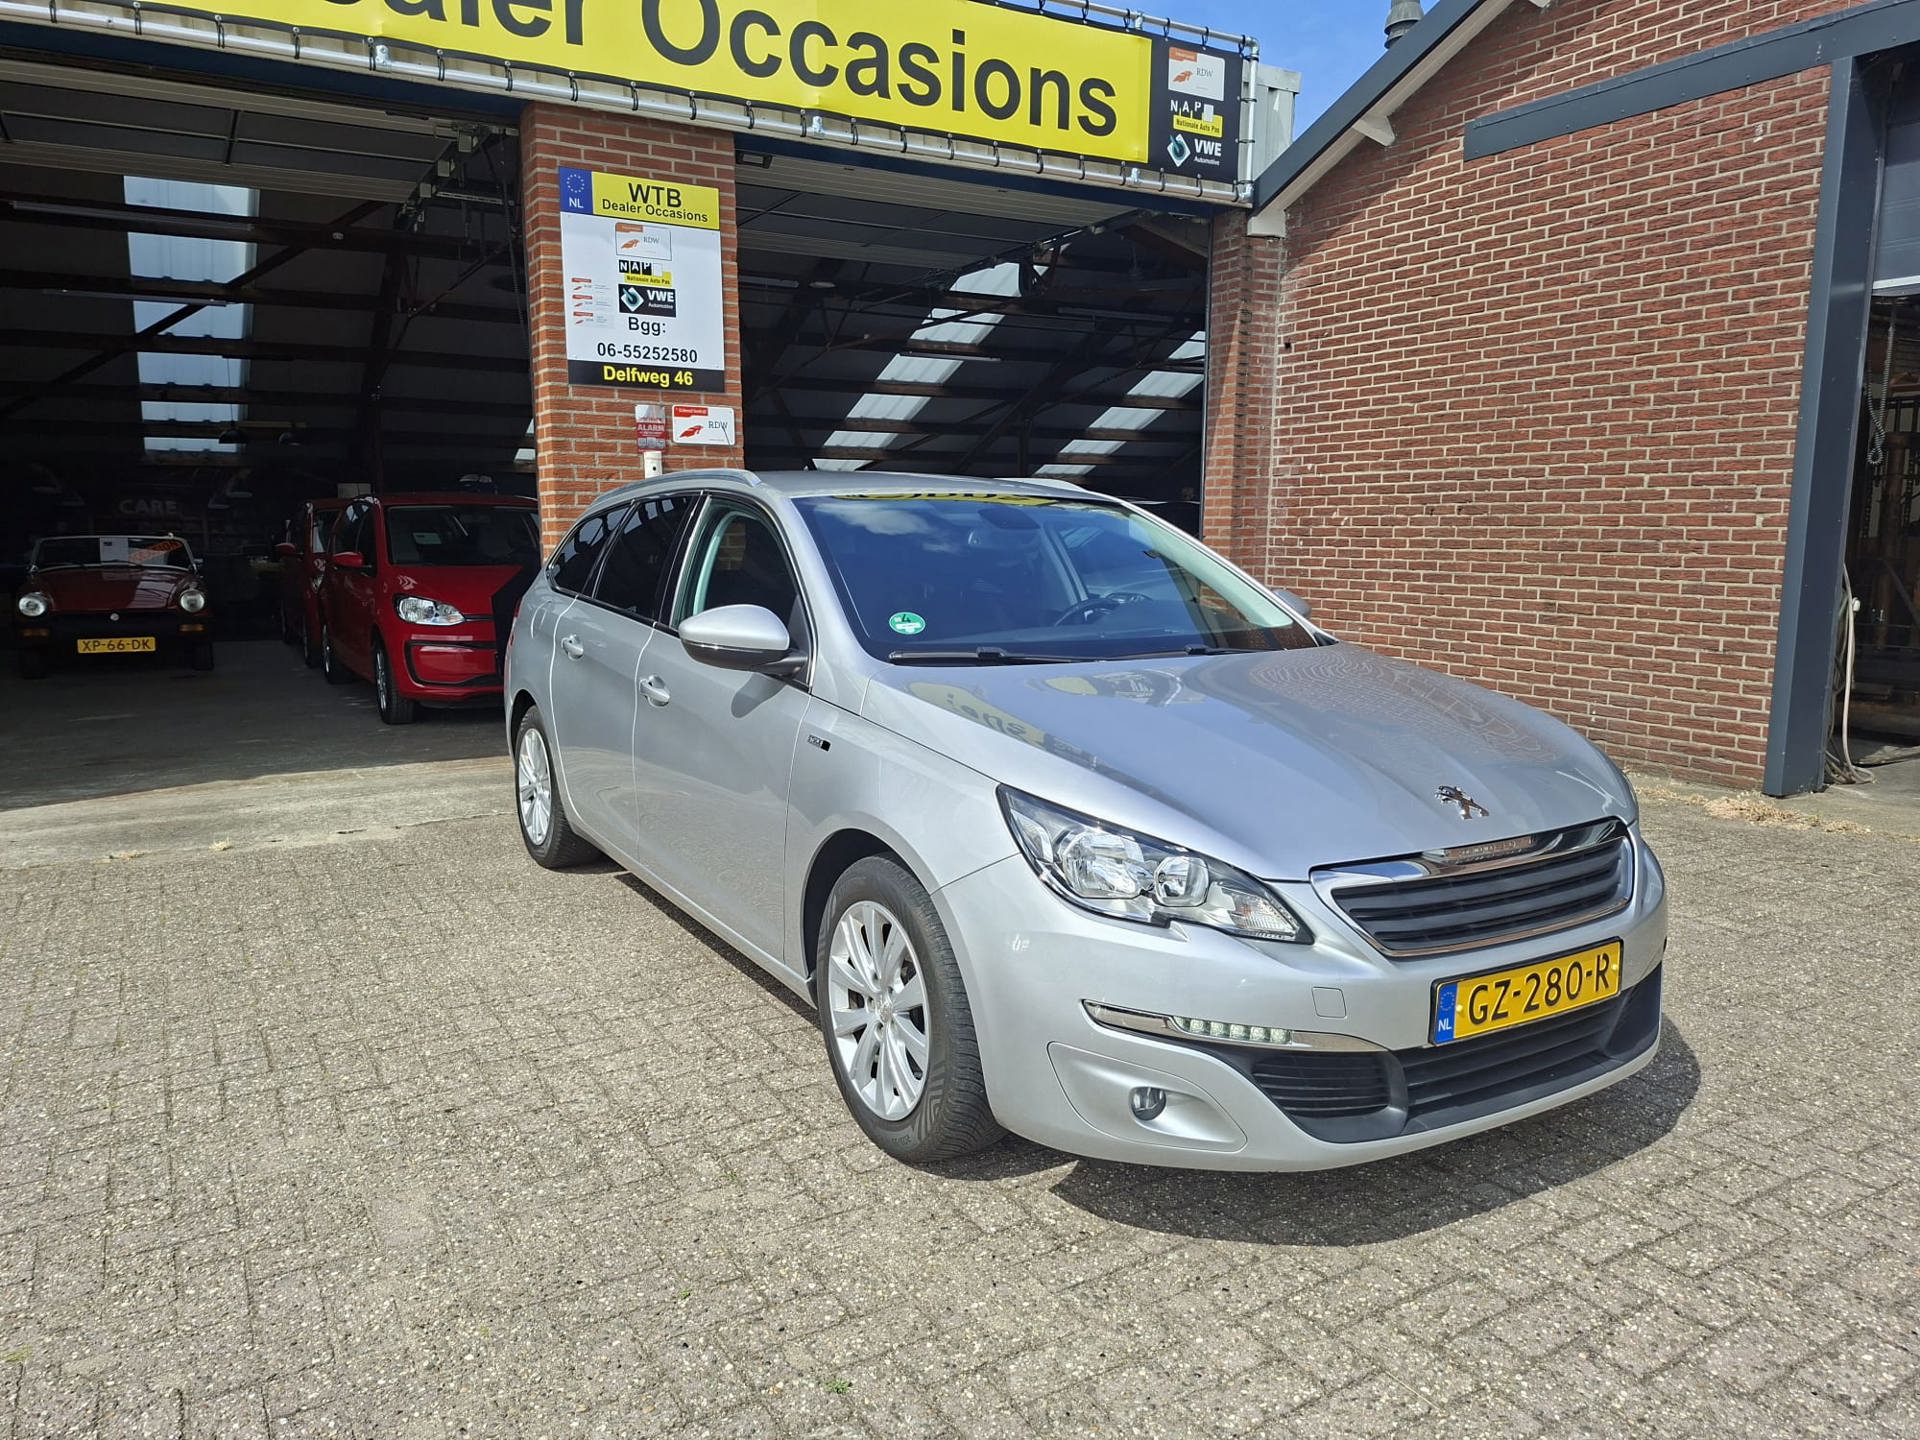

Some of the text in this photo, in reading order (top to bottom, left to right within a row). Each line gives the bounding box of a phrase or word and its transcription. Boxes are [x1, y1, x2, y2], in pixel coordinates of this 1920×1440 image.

[642, 0, 1117, 137] Occasions
[1170, 100, 1202, 112] NAP
[1199, 123, 1210, 132] Auto
[1194, 139, 1222, 156] VWE
[1194, 156, 1220, 166] Automotive
[628, 182, 682, 207] WTB
[568, 197, 584, 209] NL
[602, 199, 708, 222] Dealer Occasions
[620, 261, 650, 272] NAP
[647, 289, 674, 302] VWE
[628, 317, 666, 336] Bgg:
[597, 342, 698, 363] 06-55252580
[603, 365, 693, 388] Delfweg 46
[637, 423, 664, 432] ALARM
[708, 420, 728, 429] RDW
[119, 501, 177, 514] CARE
[82, 639, 151, 652] XP-66-DK
[1468, 952, 1610, 1025] GZ-280-R
[1438, 1018, 1452, 1033] NL
